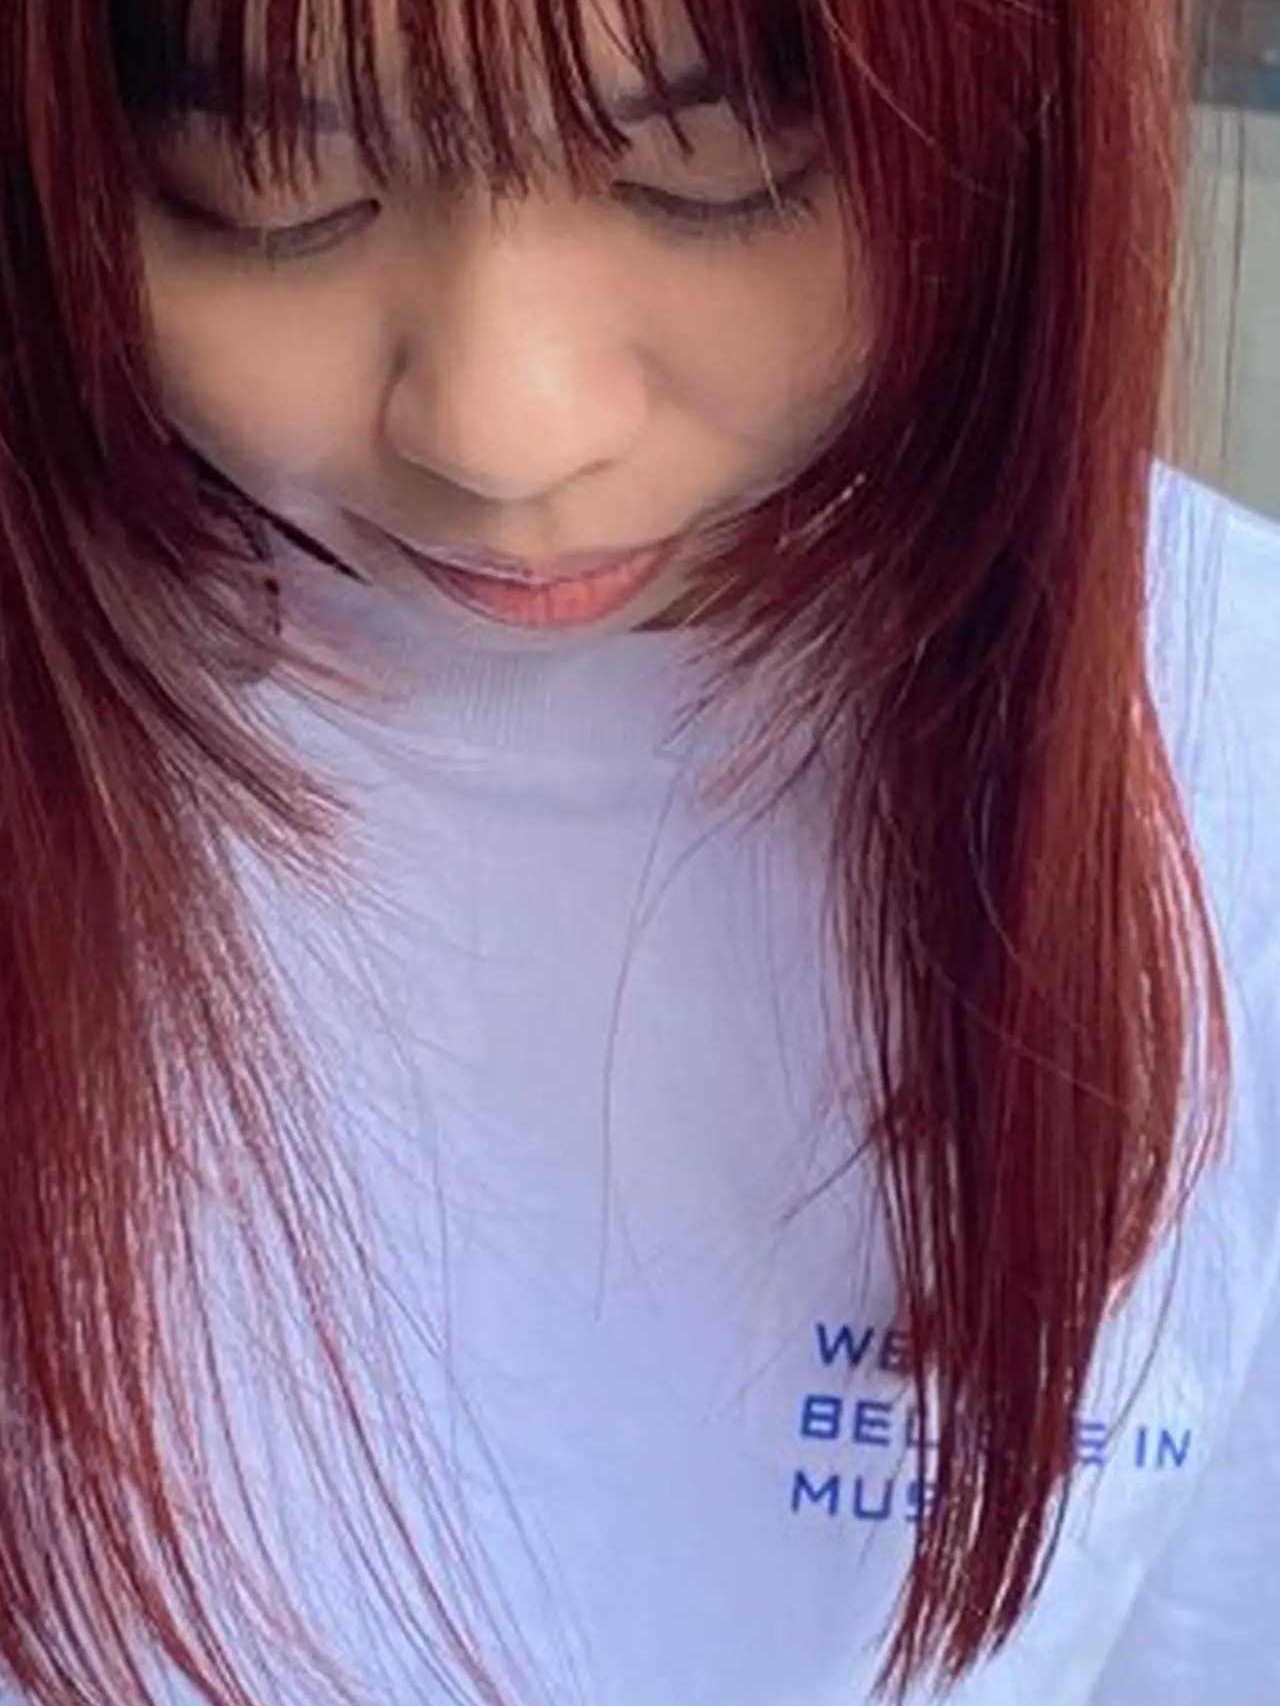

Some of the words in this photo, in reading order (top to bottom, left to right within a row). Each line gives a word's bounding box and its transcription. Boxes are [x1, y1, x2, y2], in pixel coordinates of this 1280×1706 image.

[816, 1322, 914, 1376] WE
[800, 1393, 1106, 1467] BELE
[1134, 1425, 1192, 1471] IN
